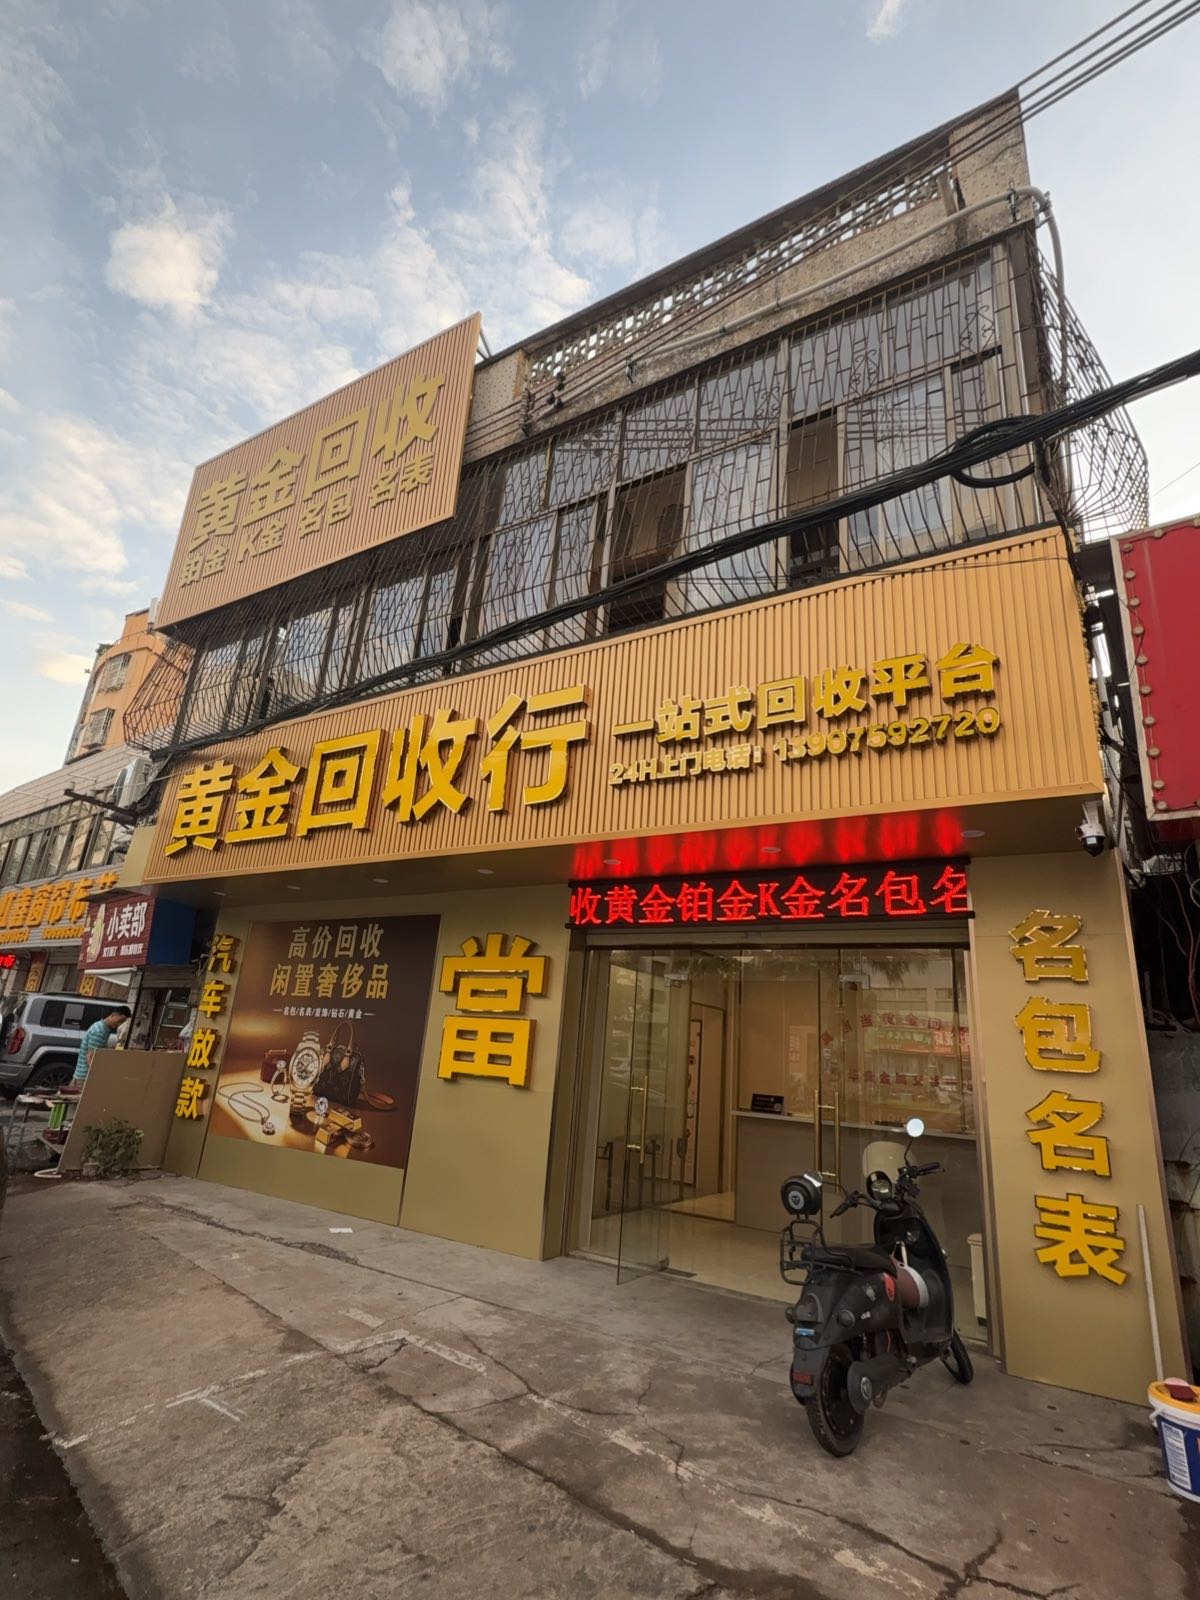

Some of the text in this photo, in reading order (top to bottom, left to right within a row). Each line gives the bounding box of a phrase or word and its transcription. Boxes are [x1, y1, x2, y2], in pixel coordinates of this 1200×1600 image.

[189, 372, 445, 551] 黄金回收
[237, 516, 287, 564] K金
[299, 487, 352, 540] 名包
[370, 453, 434, 509] 名表
[611, 642, 1000, 745] 一站式回收平台
[772, 706, 1001, 764] 13907592720
[164, 683, 590, 858] 黄金回收行
[106, 901, 148, 941] 小卖部
[287, 923, 385, 960] 高价回收
[569, 865, 969, 926] 收黄金铂金K金名包名
[175, 934, 237, 1121] 汽车放款
[269, 962, 389, 999] 闲置奢侈品
[437, 932, 549, 1087] 當
[1008, 908, 1128, 1287] 名包名表
